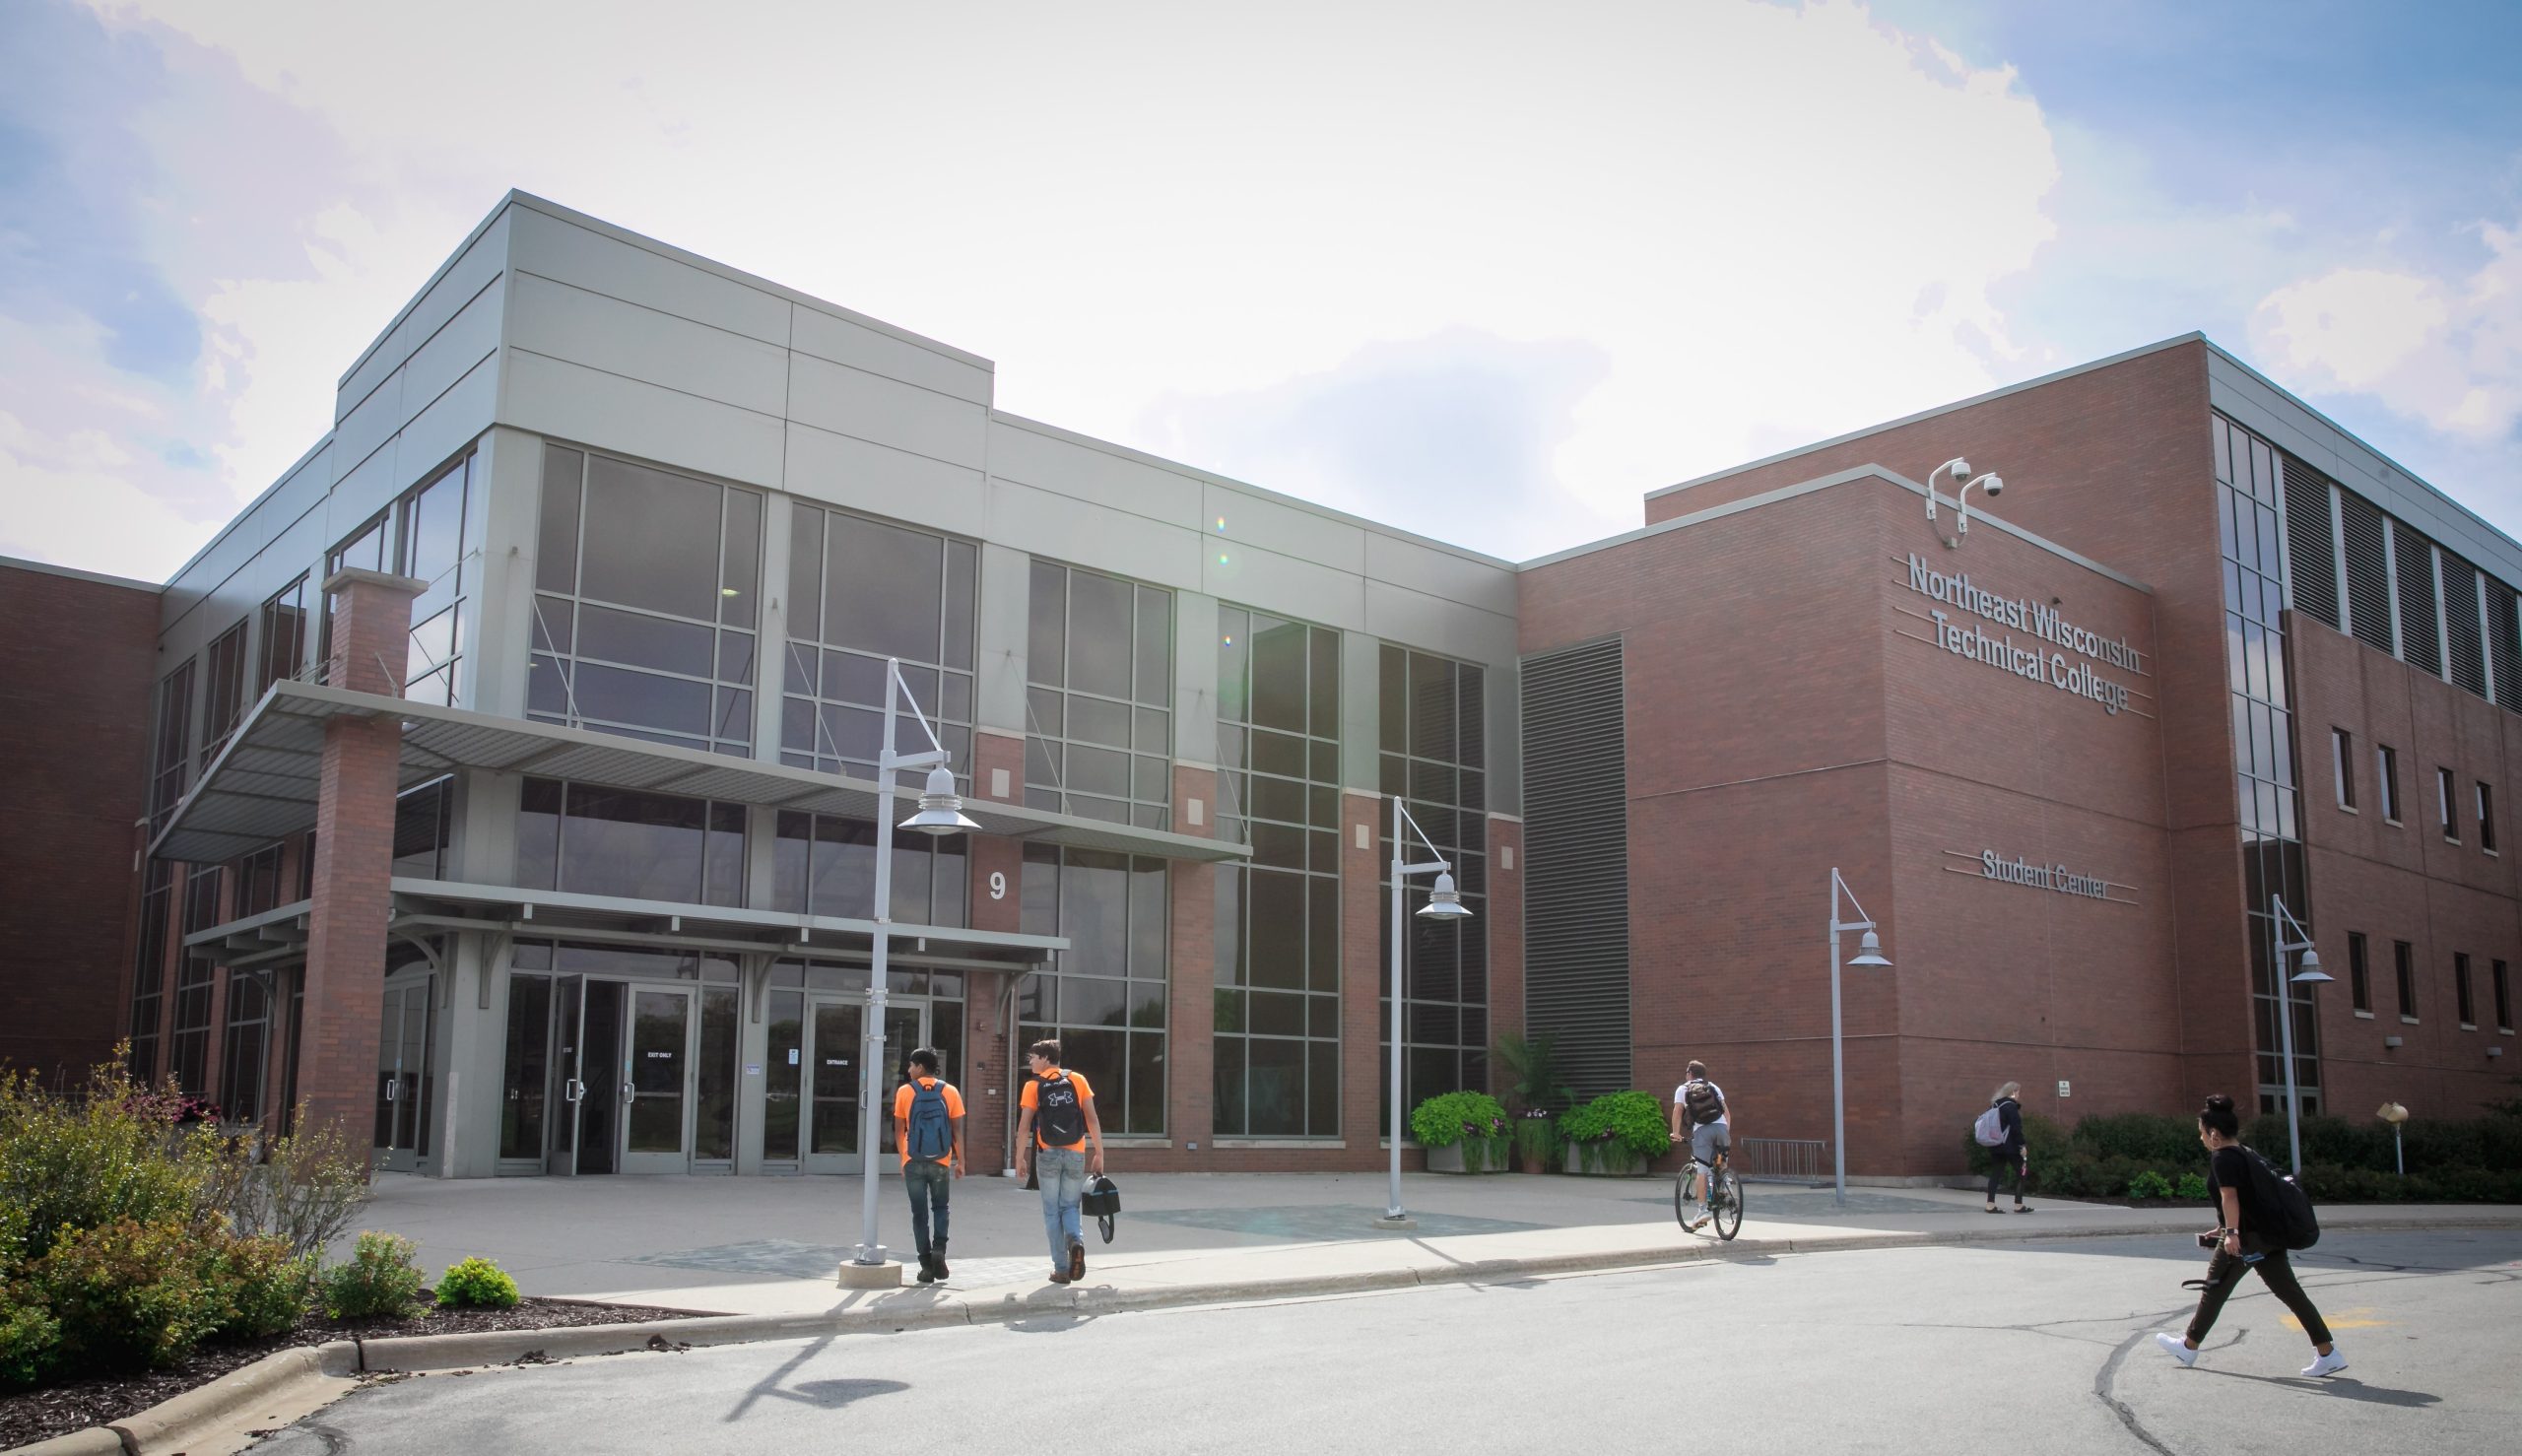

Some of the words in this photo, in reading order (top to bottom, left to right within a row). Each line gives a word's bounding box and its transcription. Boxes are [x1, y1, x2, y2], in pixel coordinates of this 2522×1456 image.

[1908, 553, 2027, 631] Northeast
[2031, 600, 2141, 674] Wisconsin
[1932, 609, 2045, 682] Technical
[2051, 653, 2129, 715] College
[990, 872, 1005, 899] 9
[1982, 849, 2051, 889] Student
[2055, 864, 2109, 898] Center
